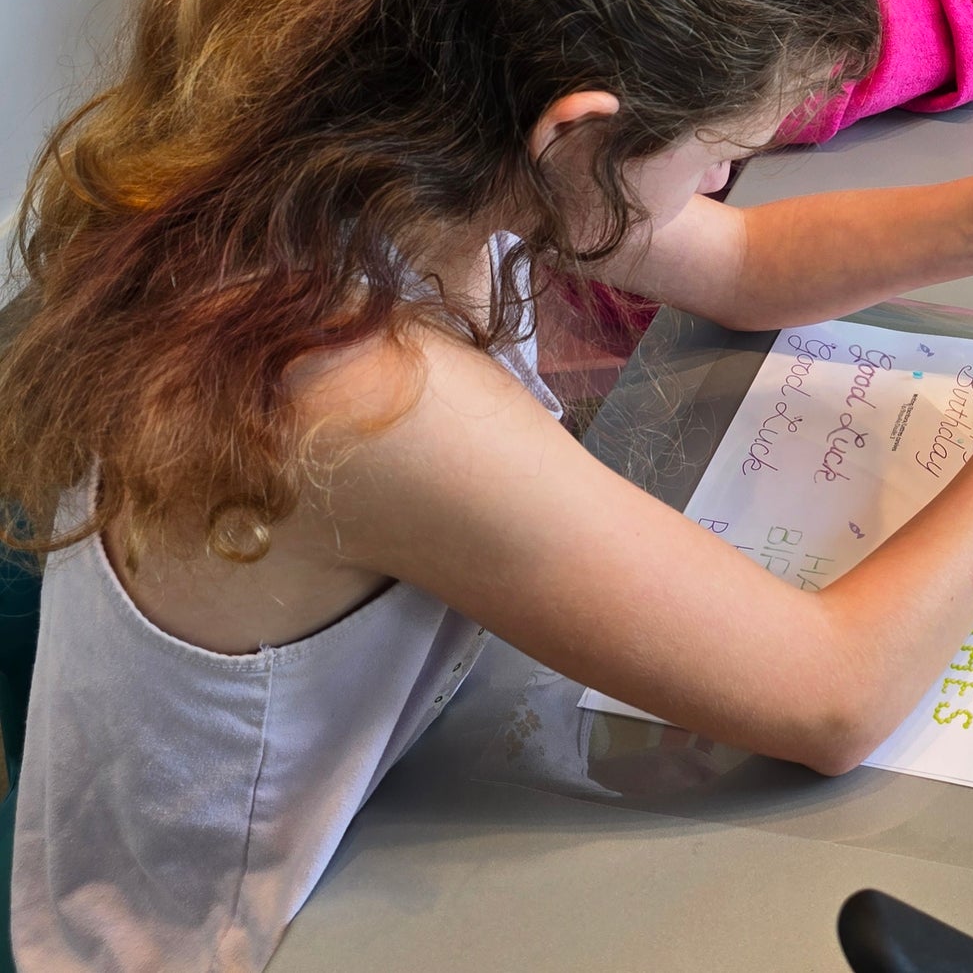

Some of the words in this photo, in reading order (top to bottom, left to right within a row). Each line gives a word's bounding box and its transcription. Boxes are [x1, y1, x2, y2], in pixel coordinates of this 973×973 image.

[780, 334, 837, 398] Good
[845, 343, 897, 409] Good
[741, 401, 804, 476] Luck
[813, 412, 870, 484] Luck
